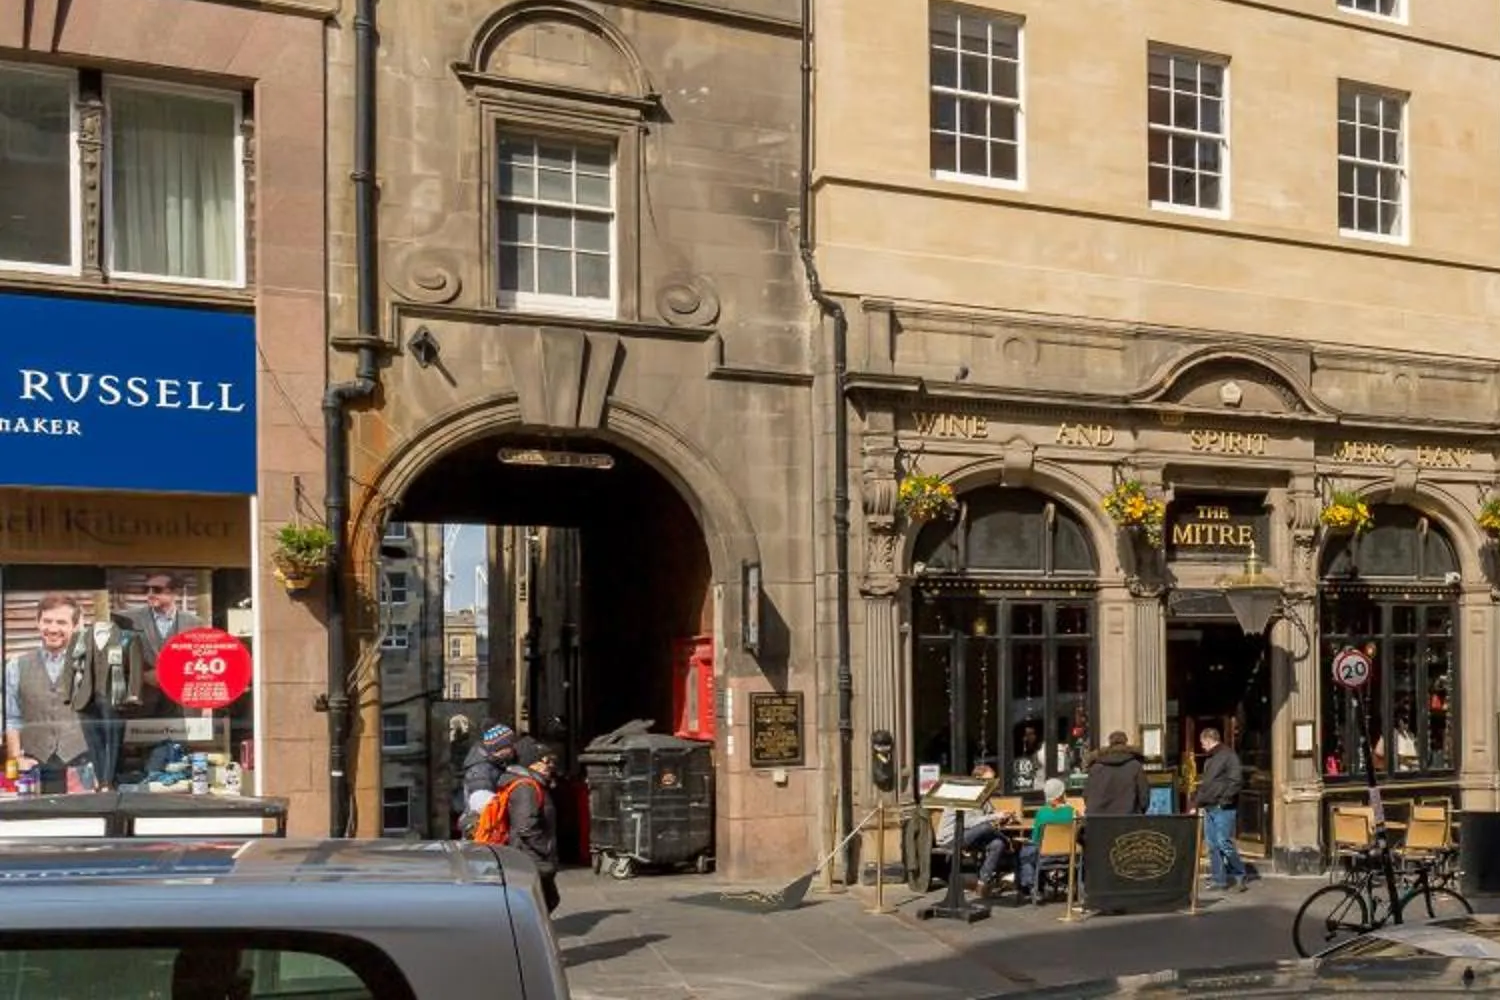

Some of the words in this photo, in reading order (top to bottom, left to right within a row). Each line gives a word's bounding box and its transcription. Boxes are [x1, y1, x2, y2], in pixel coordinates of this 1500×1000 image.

[19, 369, 246, 412] RUSSELL
[911, 412, 989, 438] WINE
[1055, 422, 1116, 448] AND
[1189, 429, 1269, 455] SPIRIT
[1196, 505, 1229, 519] THE
[1172, 523, 1254, 546] MITRE
[183, 657, 227, 675] £40
[1341, 661, 1367, 680] 20
